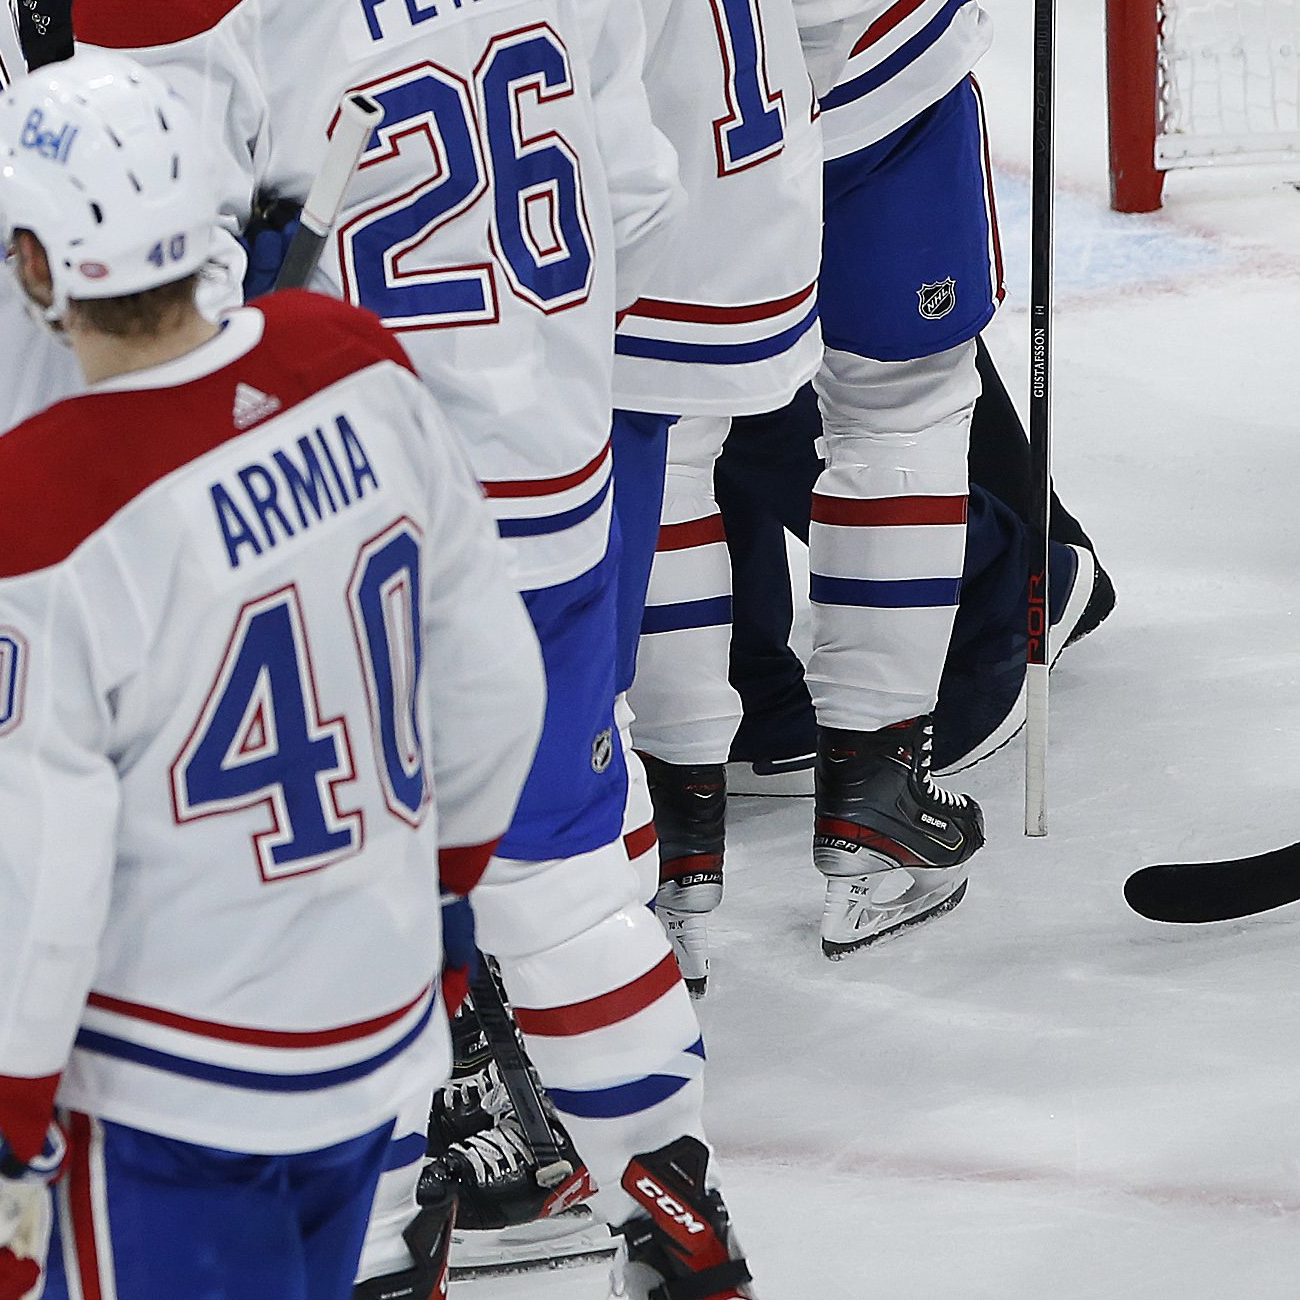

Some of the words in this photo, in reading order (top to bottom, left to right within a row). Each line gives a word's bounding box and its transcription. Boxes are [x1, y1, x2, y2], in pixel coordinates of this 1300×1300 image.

[21, 108, 78, 164] Bell
[329, 21, 596, 332] 26
[147, 232, 186, 268] 40
[1034, 327, 1046, 399] GUSTAFSSON
[208, 414, 379, 569] ARMIA
[1027, 568, 1045, 664] POR
[170, 513, 433, 884] 40
[921, 813, 948, 831] BAUER
[636, 1177, 706, 1234] CCM
